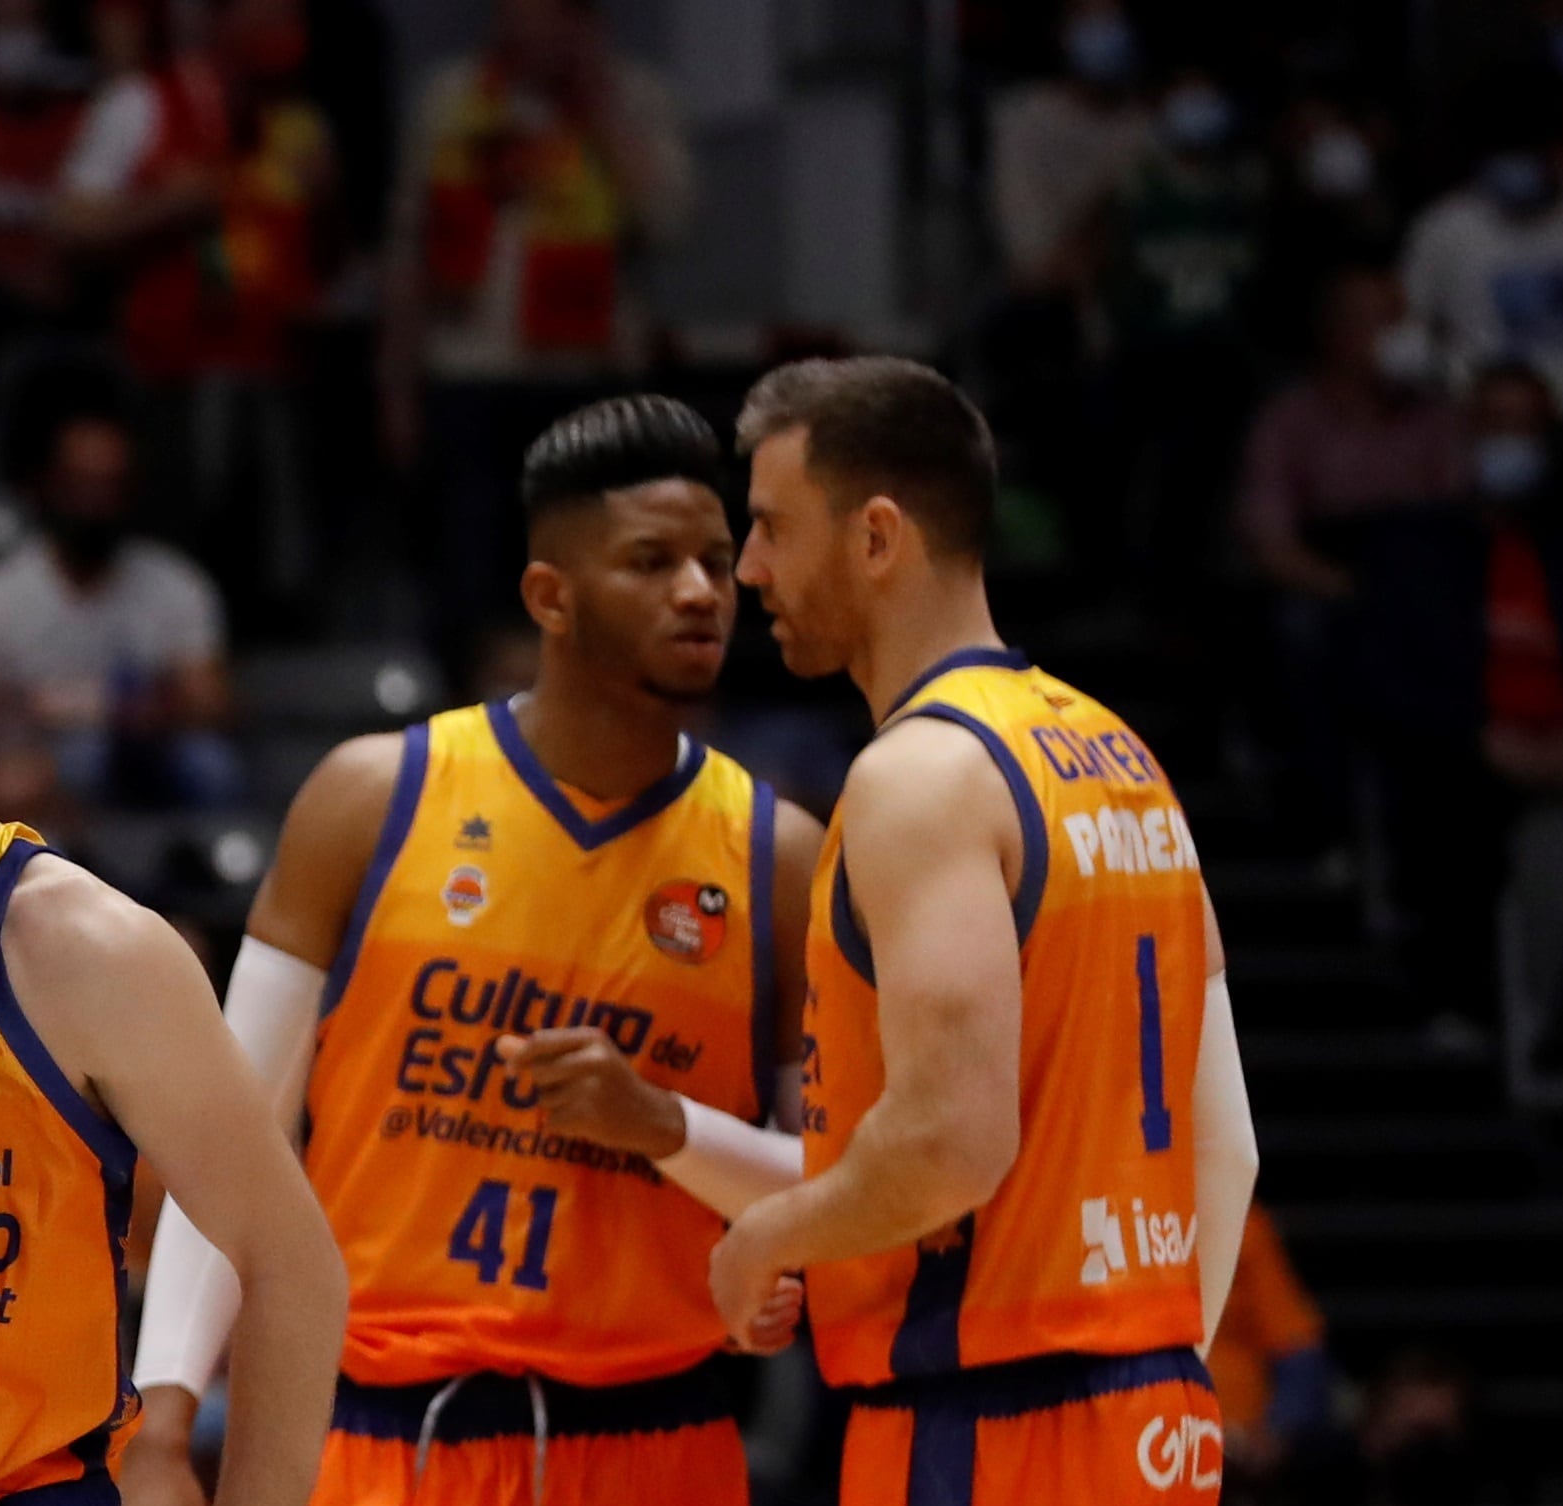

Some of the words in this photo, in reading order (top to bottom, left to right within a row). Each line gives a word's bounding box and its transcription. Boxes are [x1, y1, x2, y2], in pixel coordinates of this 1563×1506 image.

[397, 1027, 540, 1110] Esfu
[1136, 934, 1172, 1153] 1
[448, 1179, 558, 1291] 41
